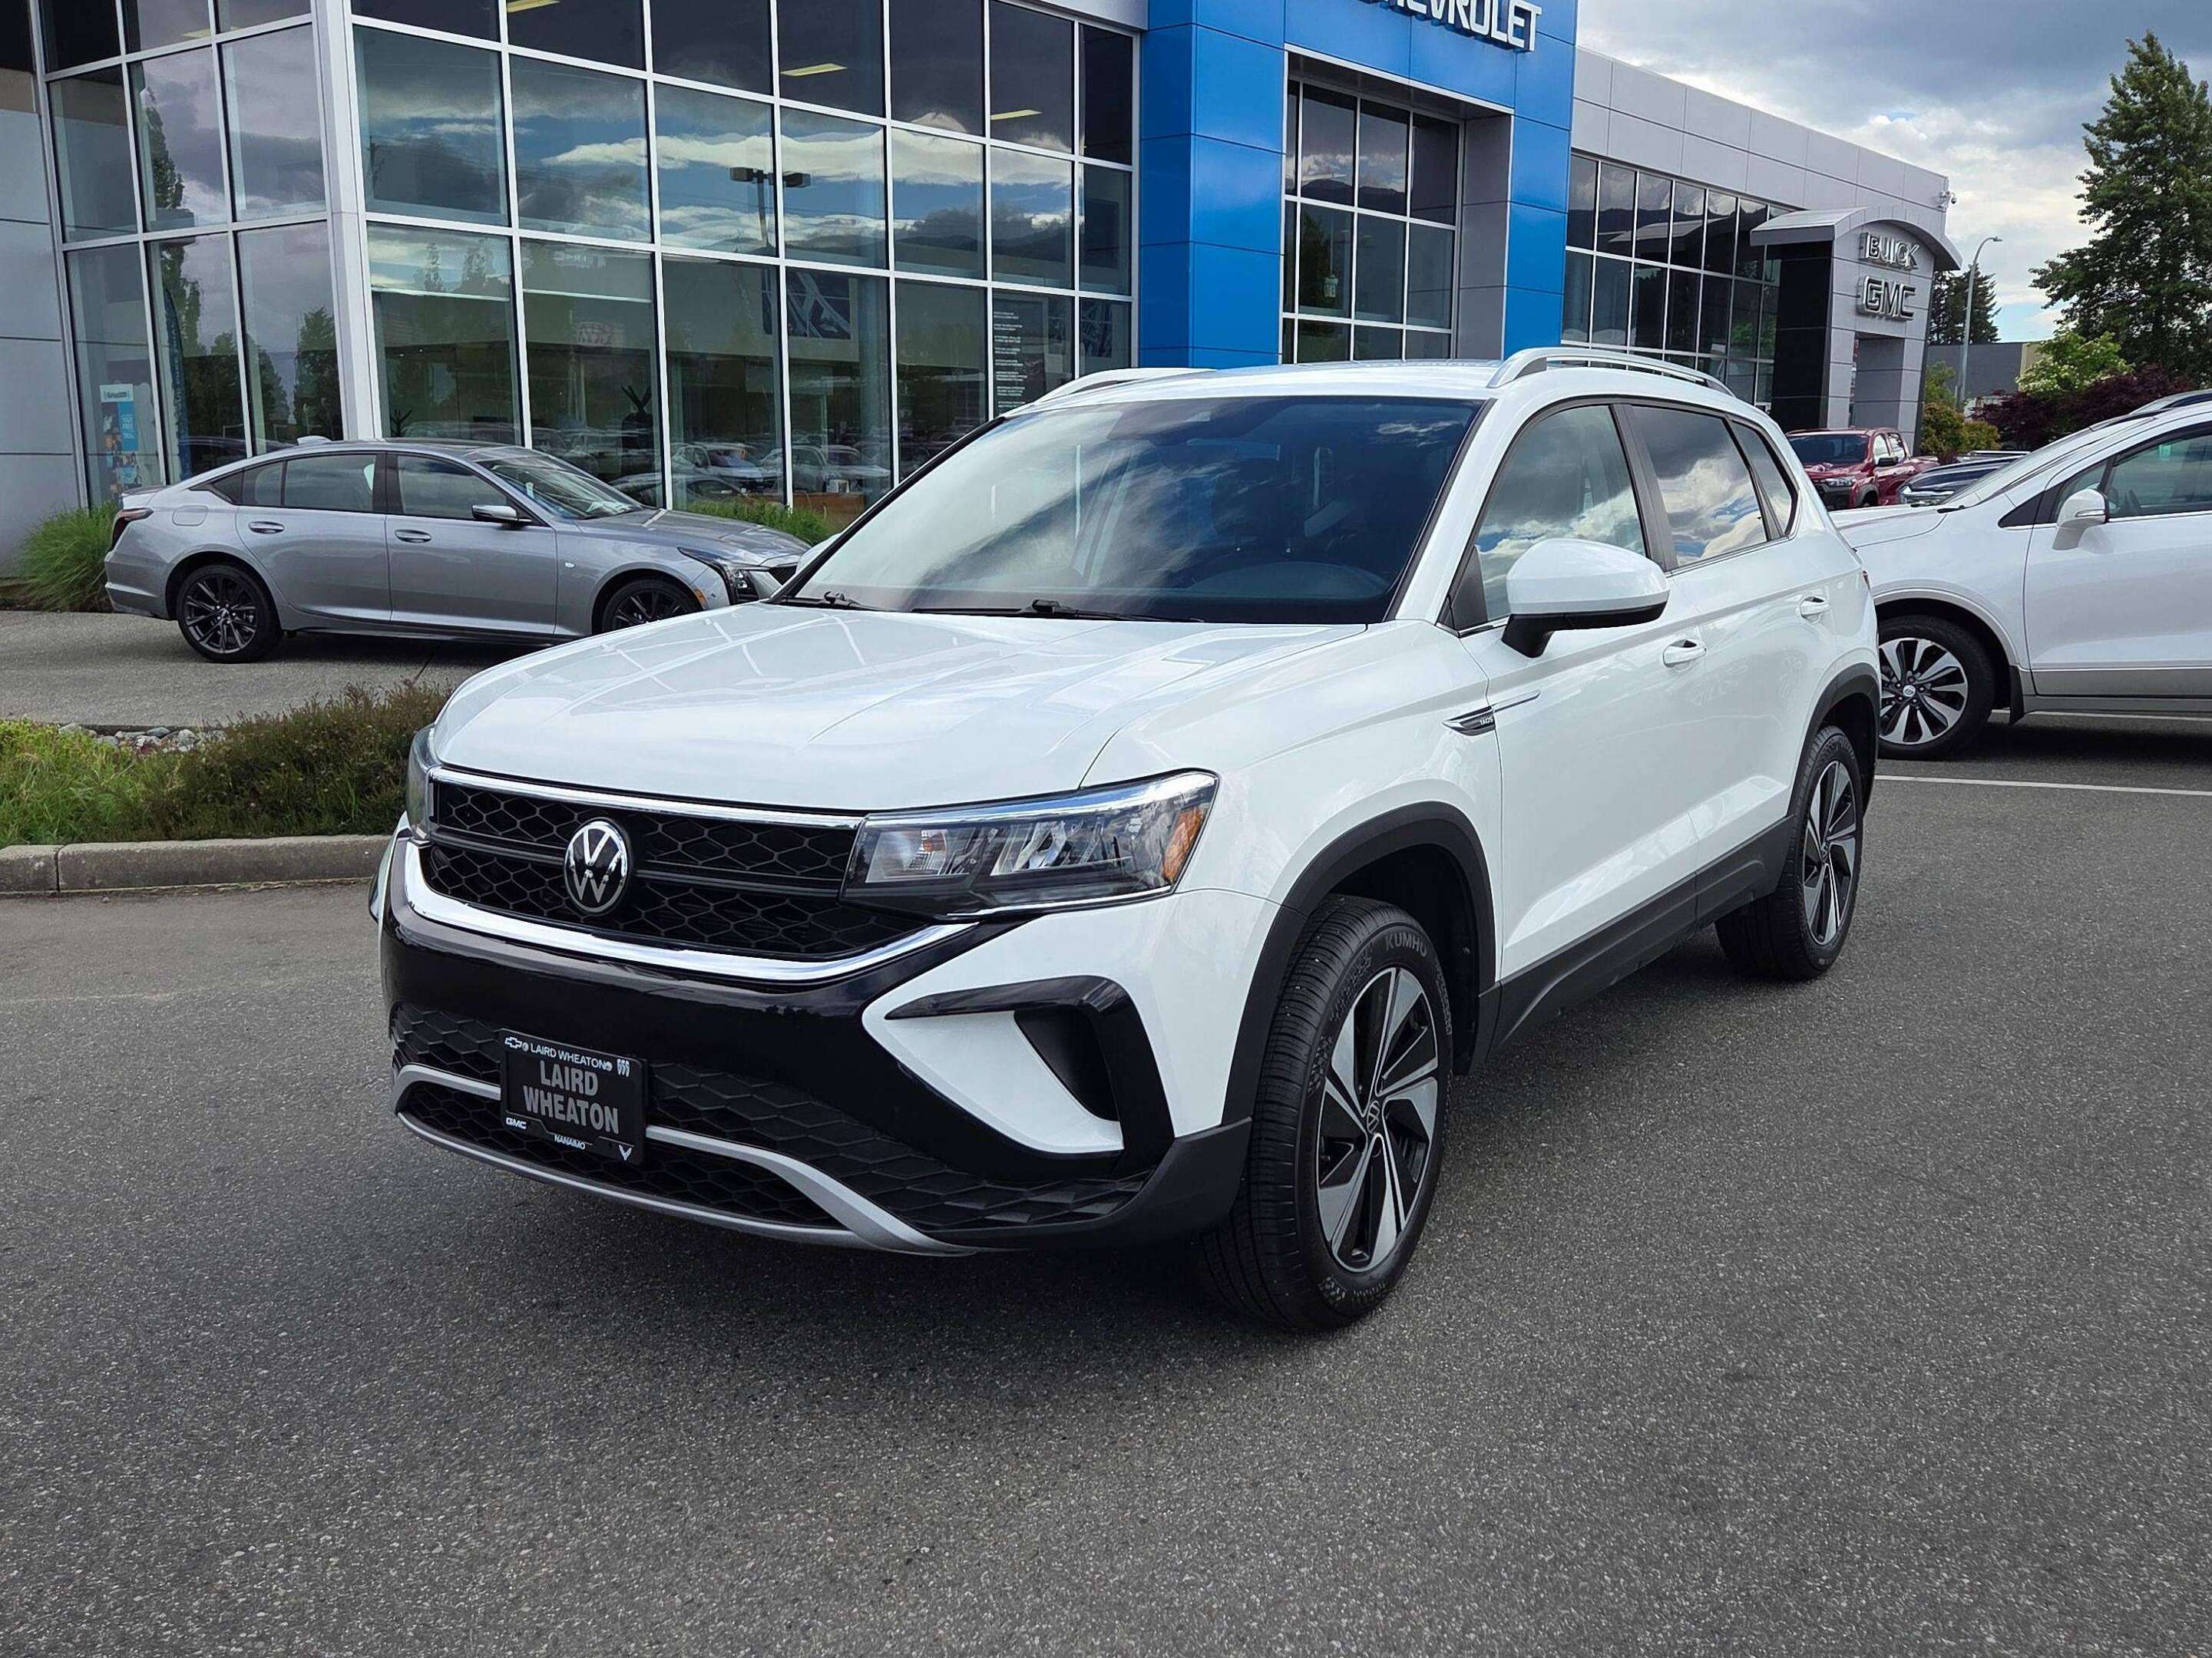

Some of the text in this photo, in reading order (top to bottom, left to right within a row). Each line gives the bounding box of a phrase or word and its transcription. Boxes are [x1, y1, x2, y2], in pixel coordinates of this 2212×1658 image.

[1863, 233, 1919, 268] BUICK
[1862, 276, 1916, 318] GMC
[530, 1042, 610, 1070] LAIRD WHEATON
[540, 1060, 599, 1097] LAIRD
[505, 1117, 527, 1130] GMC
[523, 1085, 619, 1134] WHEATON
